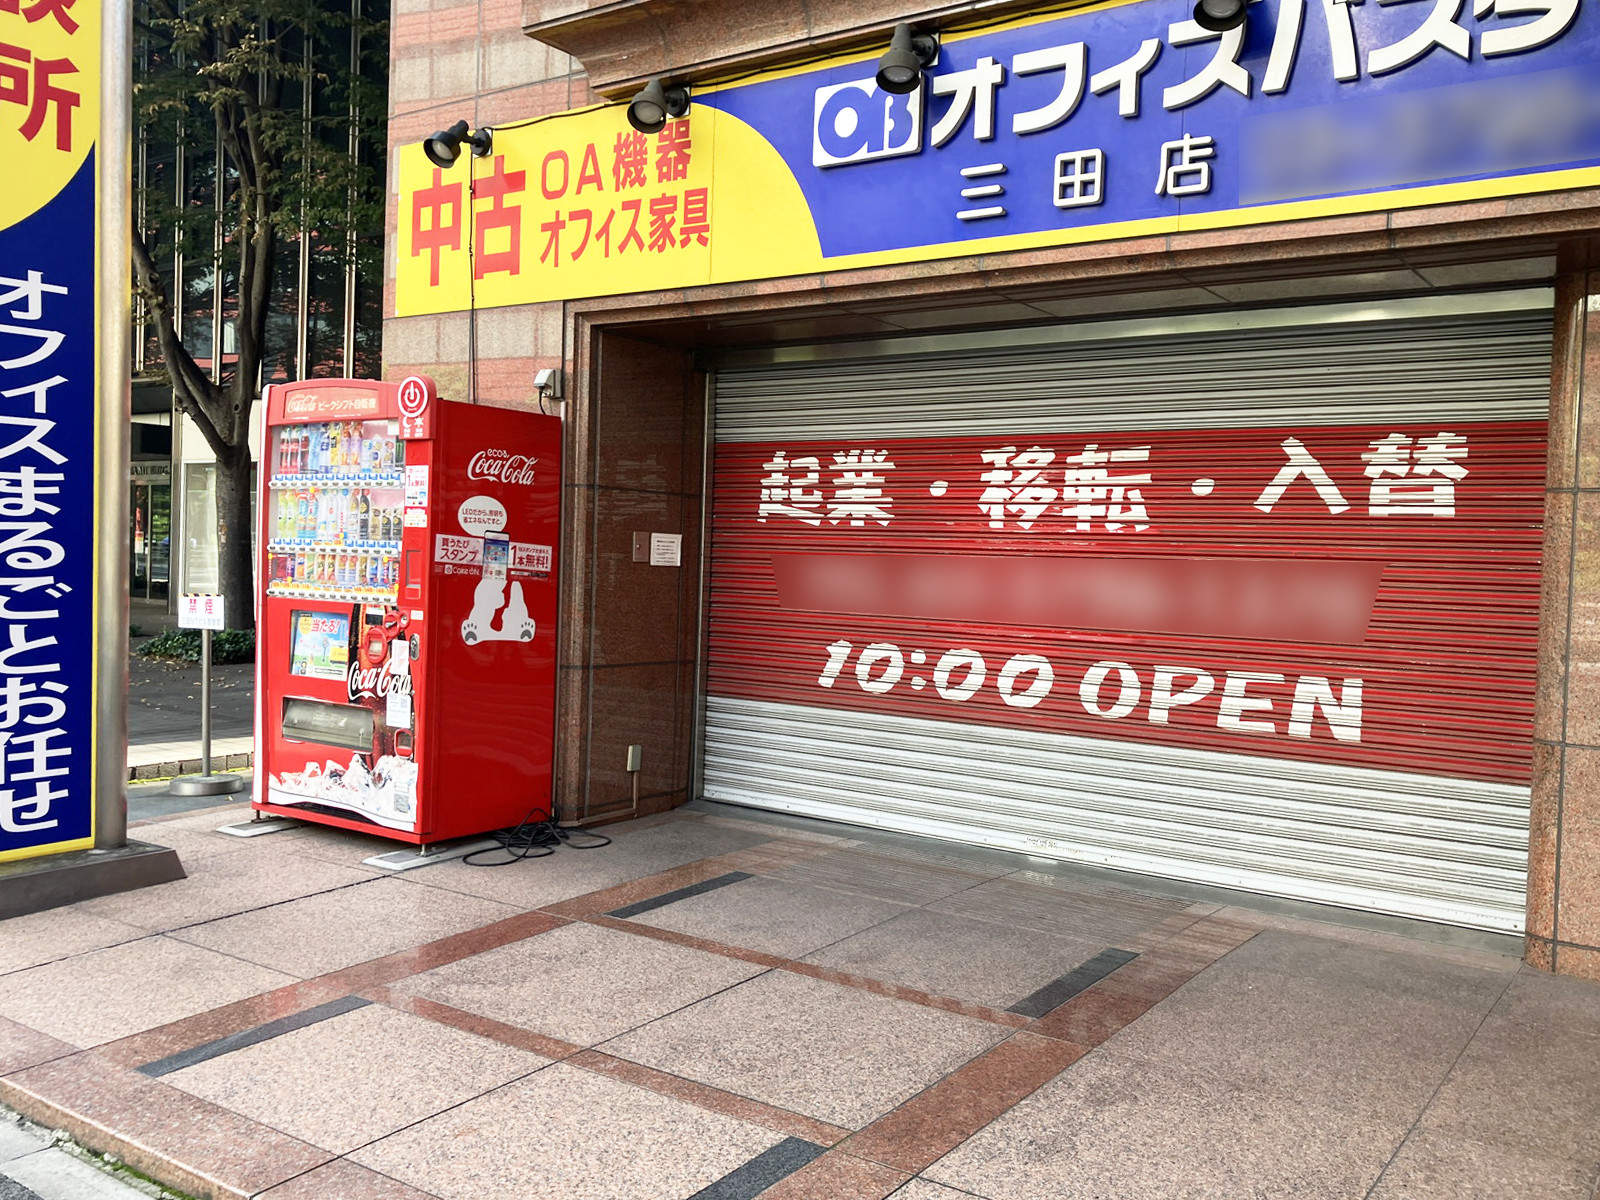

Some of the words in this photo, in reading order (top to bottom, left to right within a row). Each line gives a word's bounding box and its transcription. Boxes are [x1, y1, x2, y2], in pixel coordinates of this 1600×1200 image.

[540, 118, 692, 200] OA機器
[956, 133, 1216, 221] 三田店
[411, 154, 527, 287] 中古
[540, 187, 711, 268] オフィス家具
[467, 451, 539, 486] Coca-Cola
[0, 270, 74, 833] オフィスまるごとお任せ
[440, 548, 479, 562] スタンプ
[817, 638, 1056, 709] 10:00
[1078, 661, 1365, 744] OPEN
